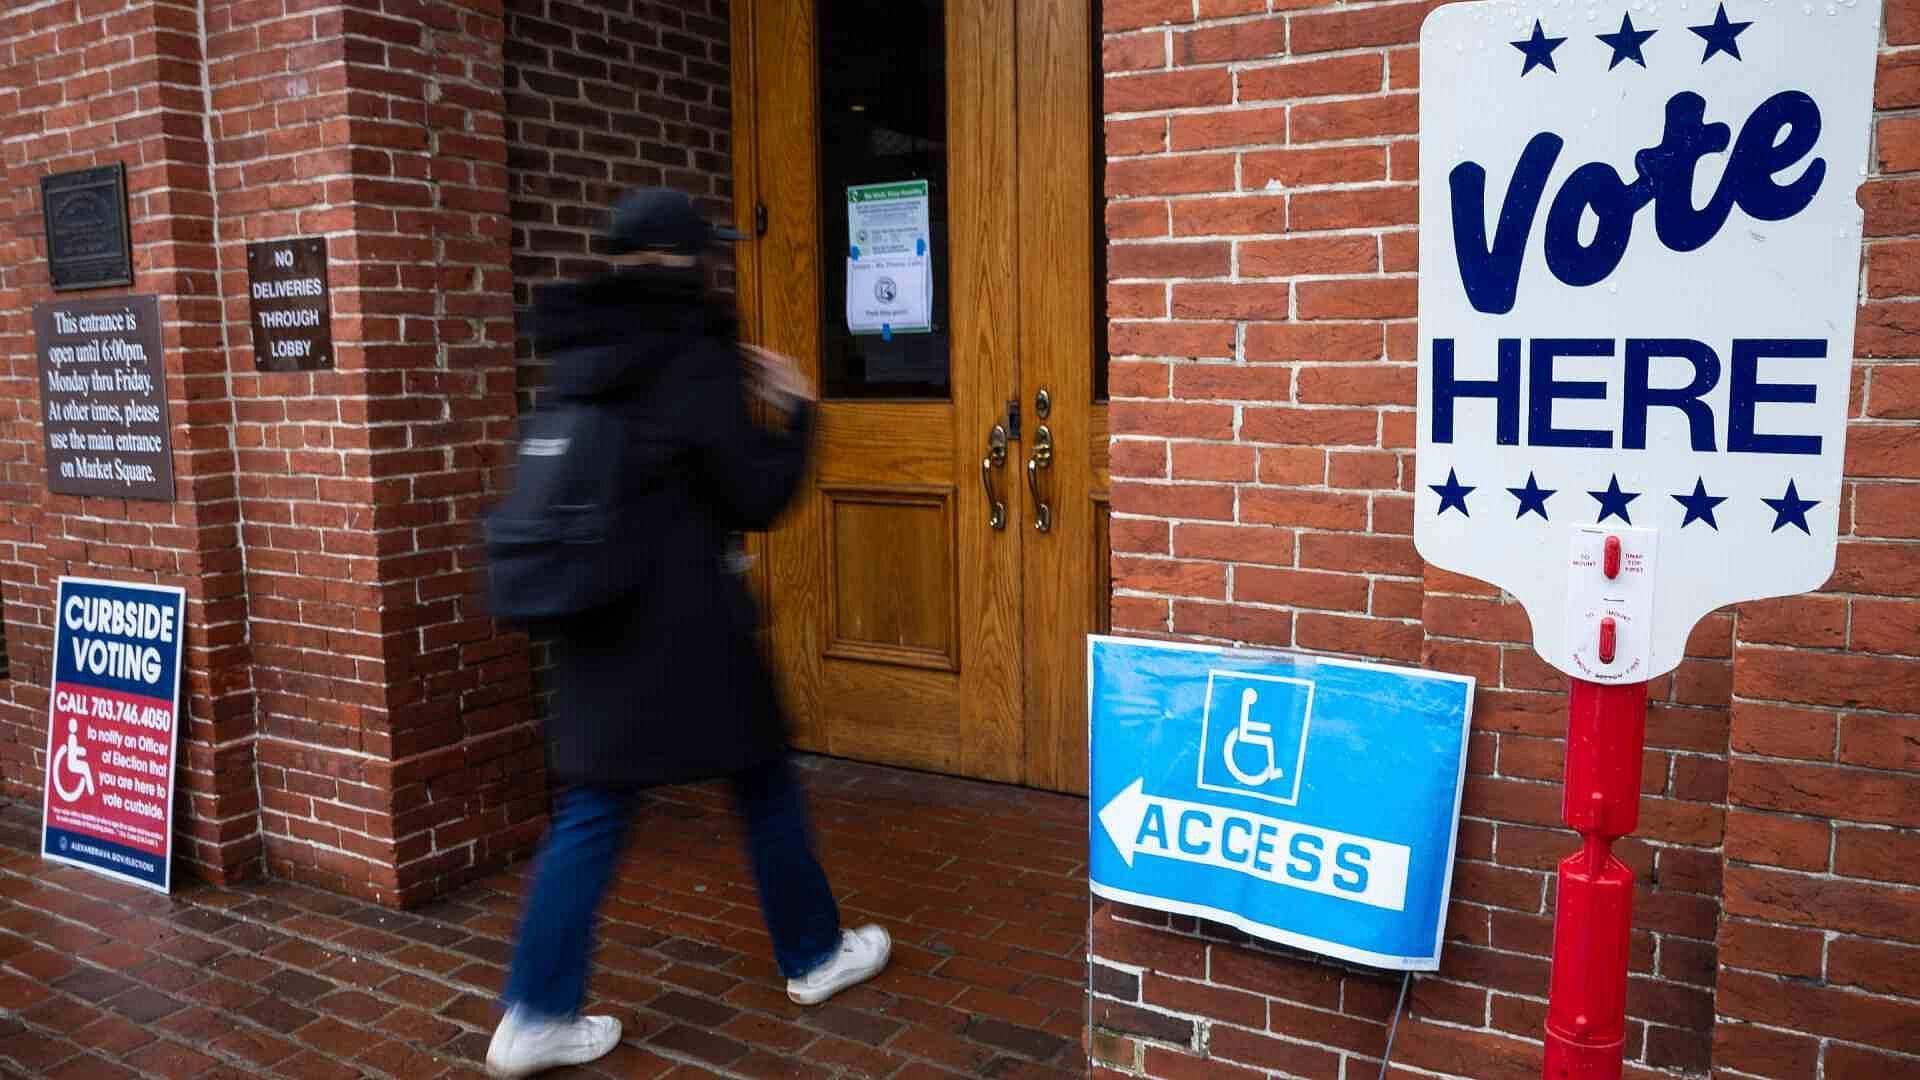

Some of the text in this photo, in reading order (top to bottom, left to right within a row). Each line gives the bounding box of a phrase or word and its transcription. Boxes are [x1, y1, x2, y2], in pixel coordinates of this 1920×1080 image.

[1449, 90, 1826, 314] Vote
[275, 250, 293, 267] NO
[253, 278, 322, 299] DELIVERIES
[54, 308, 136, 334] This entrance is
[258, 309, 320, 328] THROUGH
[49, 339, 147, 368] open until 6:00pm,
[271, 340, 311, 358] LOBBY
[48, 369, 153, 396] Monday thru Friday.
[1431, 338, 1828, 455] HERE
[49, 401, 61, 421] At
[63, 400, 89, 421] other
[125, 399, 159, 427] please
[50, 429, 162, 453] use the main entrance
[60, 456, 156, 486] on Market Square.
[65, 595, 174, 642] CURBSIDE
[72, 636, 162, 684] VOTING
[56, 691, 171, 732] CALL 703.746.4050
[87, 725, 168, 755] to notify an Officer
[102, 751, 167, 777] of Election that
[99, 771, 166, 799] you are here to
[102, 793, 165, 820] vote curbside.
[1135, 803, 1371, 893] ACCESS
